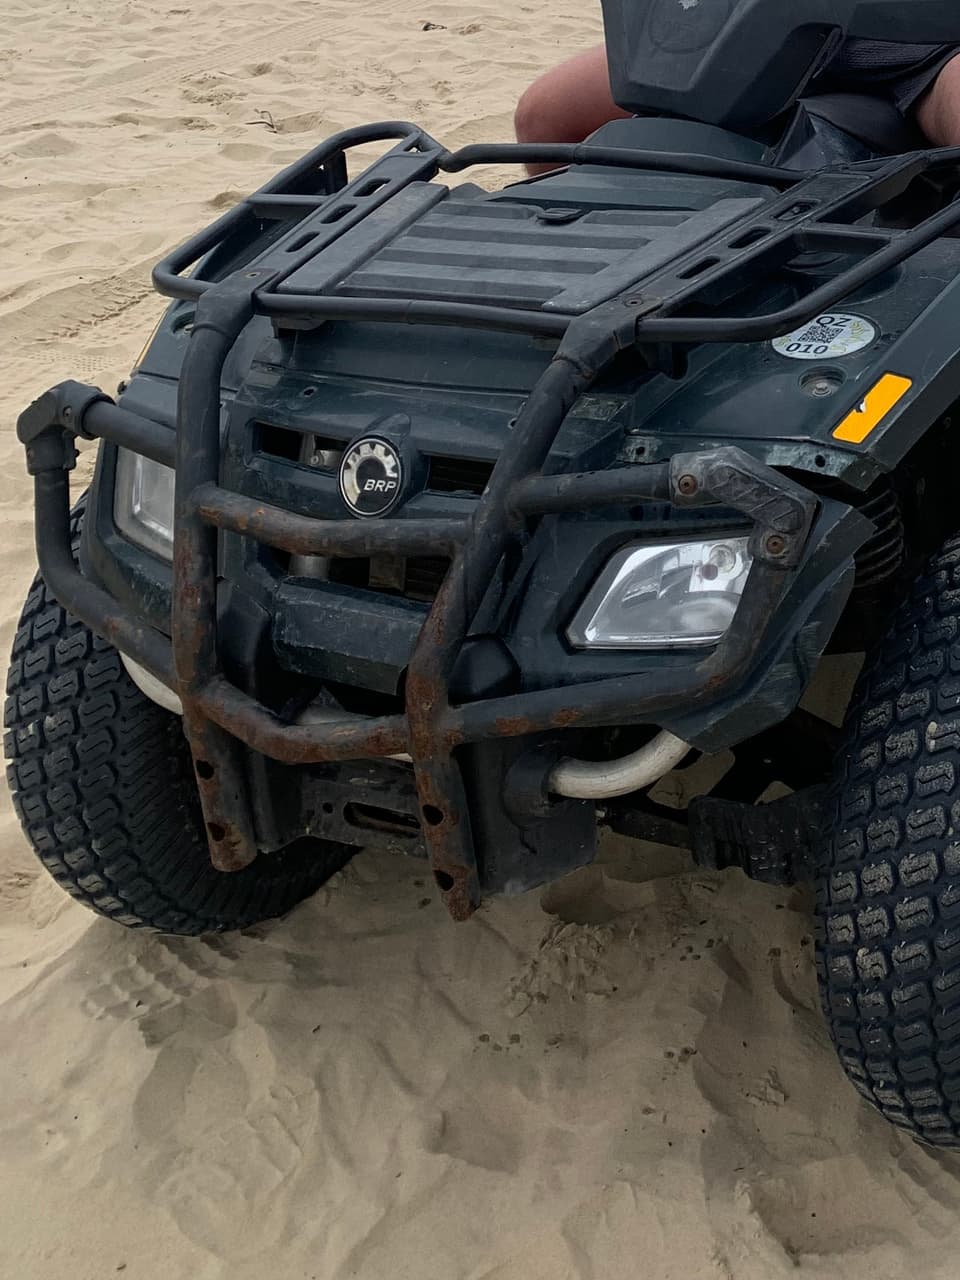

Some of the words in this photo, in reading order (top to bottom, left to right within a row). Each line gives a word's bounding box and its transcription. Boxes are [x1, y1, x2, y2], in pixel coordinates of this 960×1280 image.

[815, 315, 852, 328] QZ
[785, 342, 829, 355] 010
[363, 478, 397, 493] BRP
